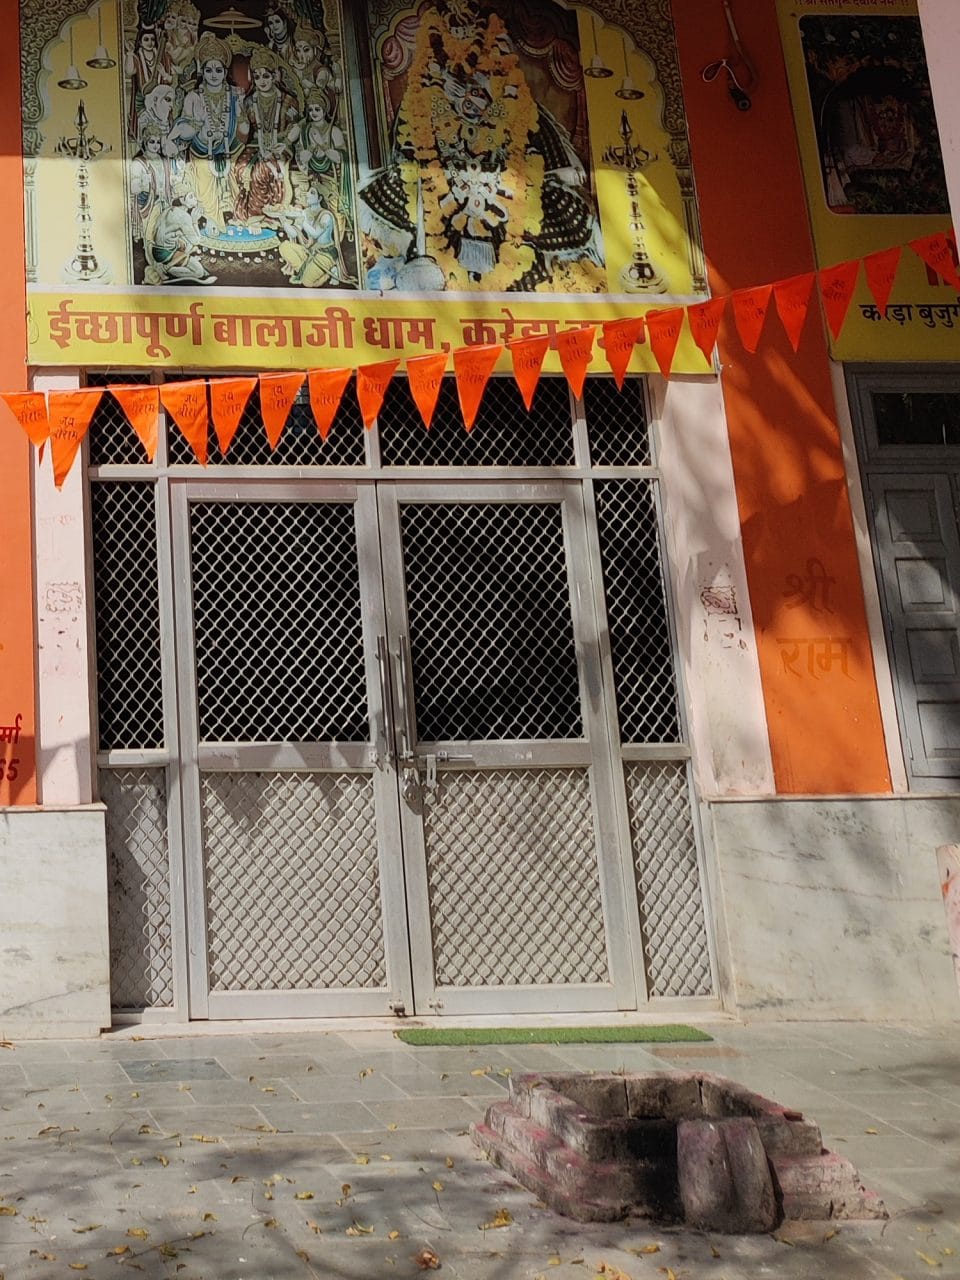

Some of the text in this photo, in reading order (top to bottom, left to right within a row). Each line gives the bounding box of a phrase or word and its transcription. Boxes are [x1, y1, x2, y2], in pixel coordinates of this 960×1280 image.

[48, 299, 205, 359] ईच्छापूर्ण
[211, 307, 355, 349] बालाजी
[776, 637, 856, 681] राम
